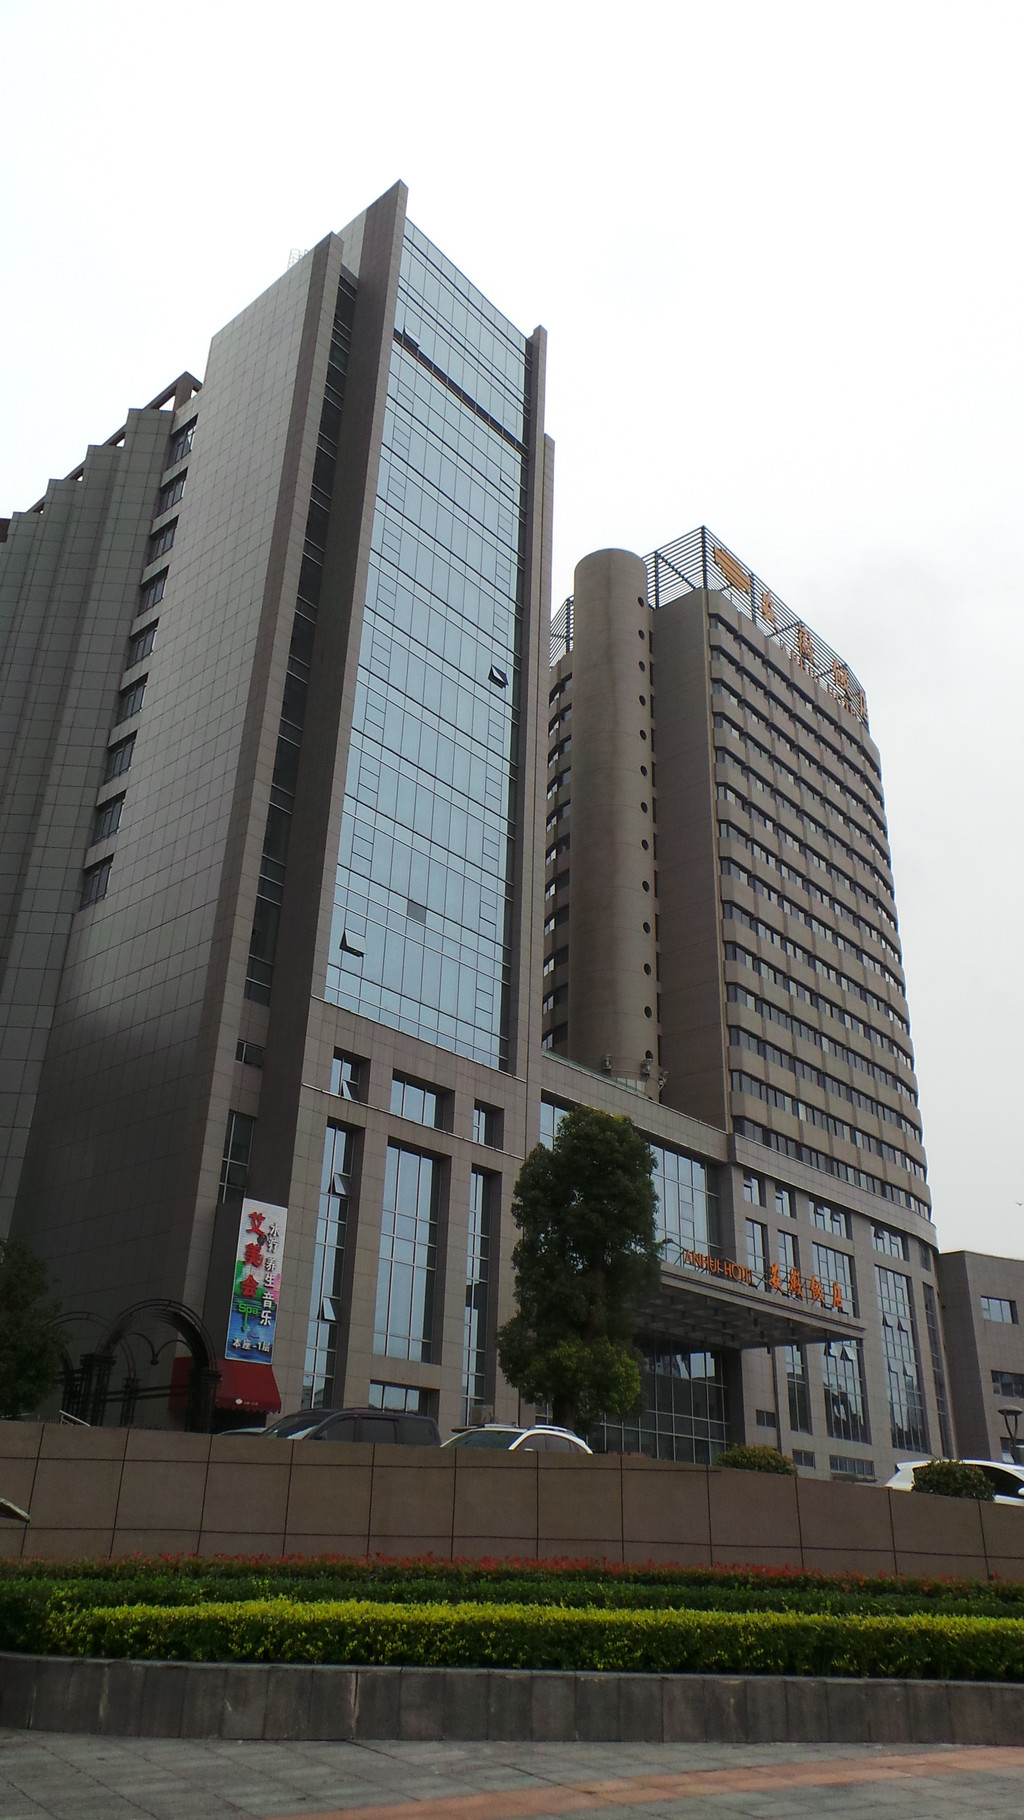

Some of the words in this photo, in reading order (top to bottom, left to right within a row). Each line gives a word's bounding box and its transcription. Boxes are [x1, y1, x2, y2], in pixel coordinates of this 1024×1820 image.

[241, 1211, 266, 1297] 艾美会
[260, 1223, 280, 1326] 水疗养生音乐
[685, 1250, 720, 1274] ANHUI
[723, 1261, 755, 1286] HOTEL
[232, 1338, 271, 1353] 本座-1层
